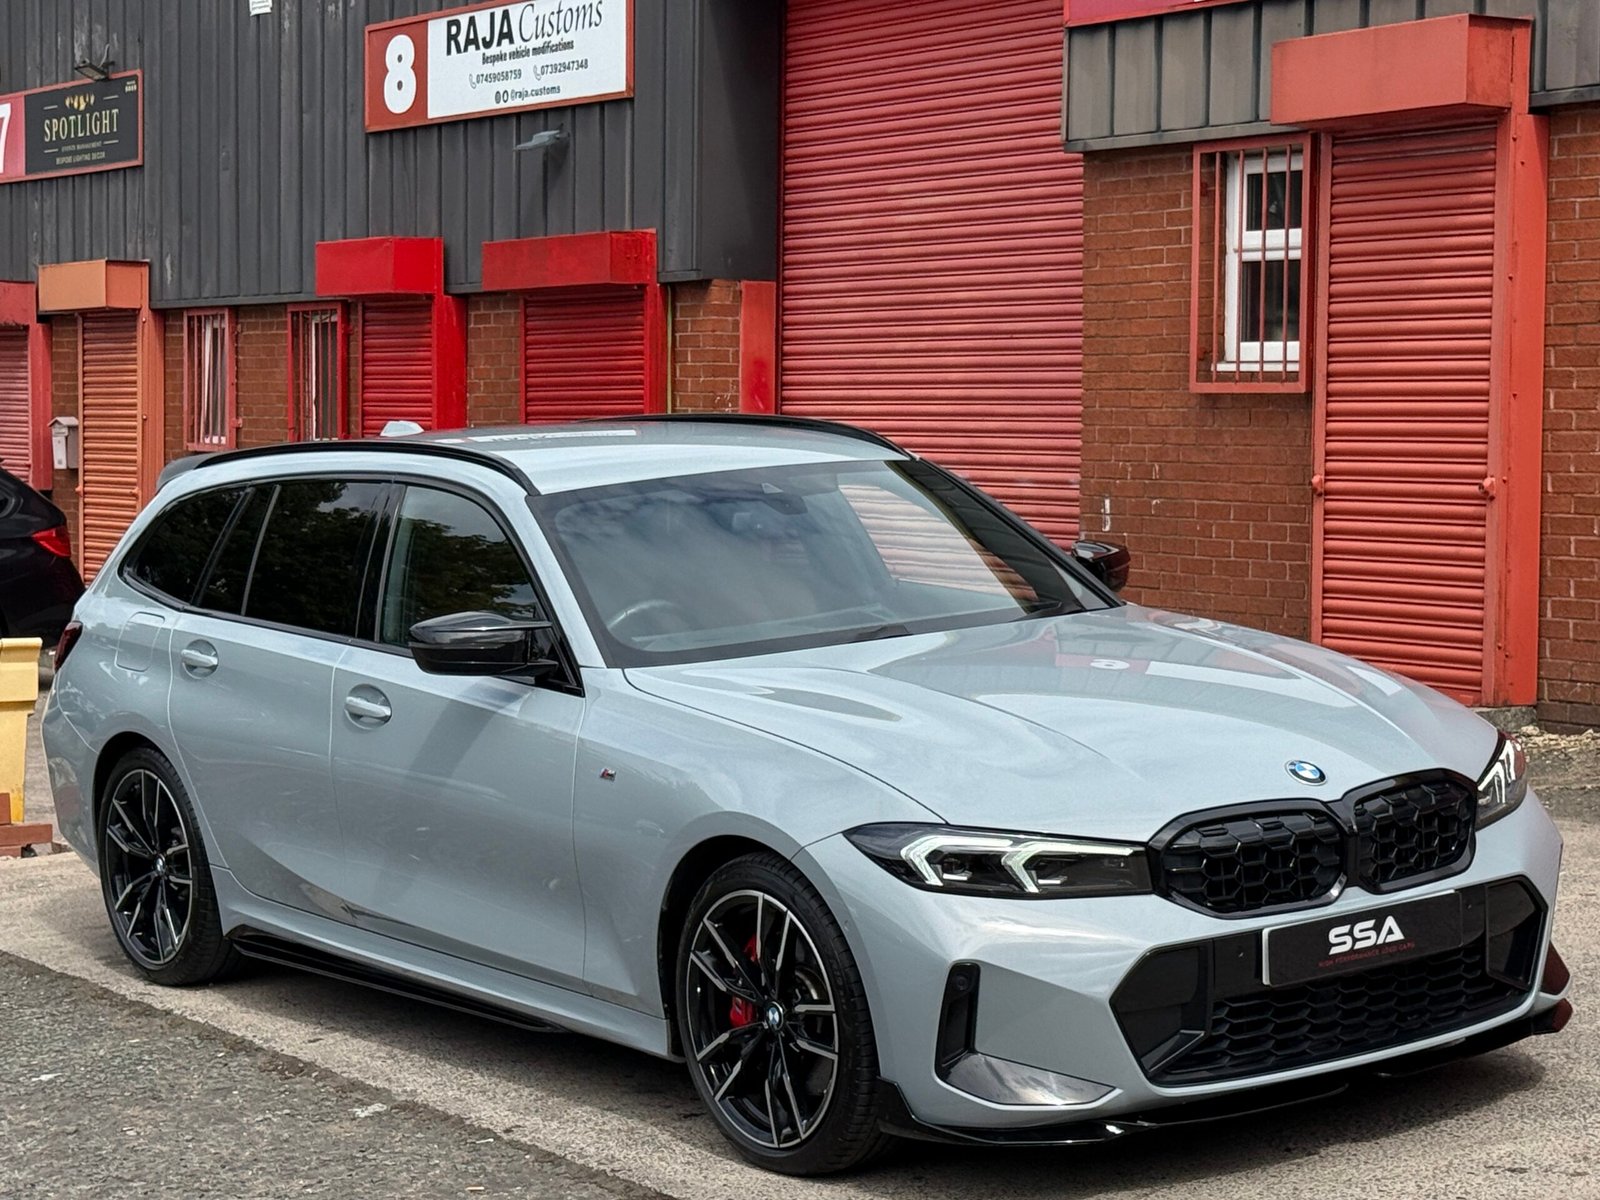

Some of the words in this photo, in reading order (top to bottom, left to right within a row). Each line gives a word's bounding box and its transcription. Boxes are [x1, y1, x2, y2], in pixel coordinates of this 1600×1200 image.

[446, 8, 515, 56] RAJA
[518, 0, 603, 43] Customs
[482, 50, 507, 66] Bespoke
[508, 45, 530, 61] vehicle
[532, 38, 574, 56] modifications
[384, 34, 417, 114] 8
[476, 69, 522, 84] 07459058759
[540, 59, 589, 76] 07392947348
[44, 109, 119, 142] SPOTLIGHT
[1328, 915, 1405, 955] SSA
